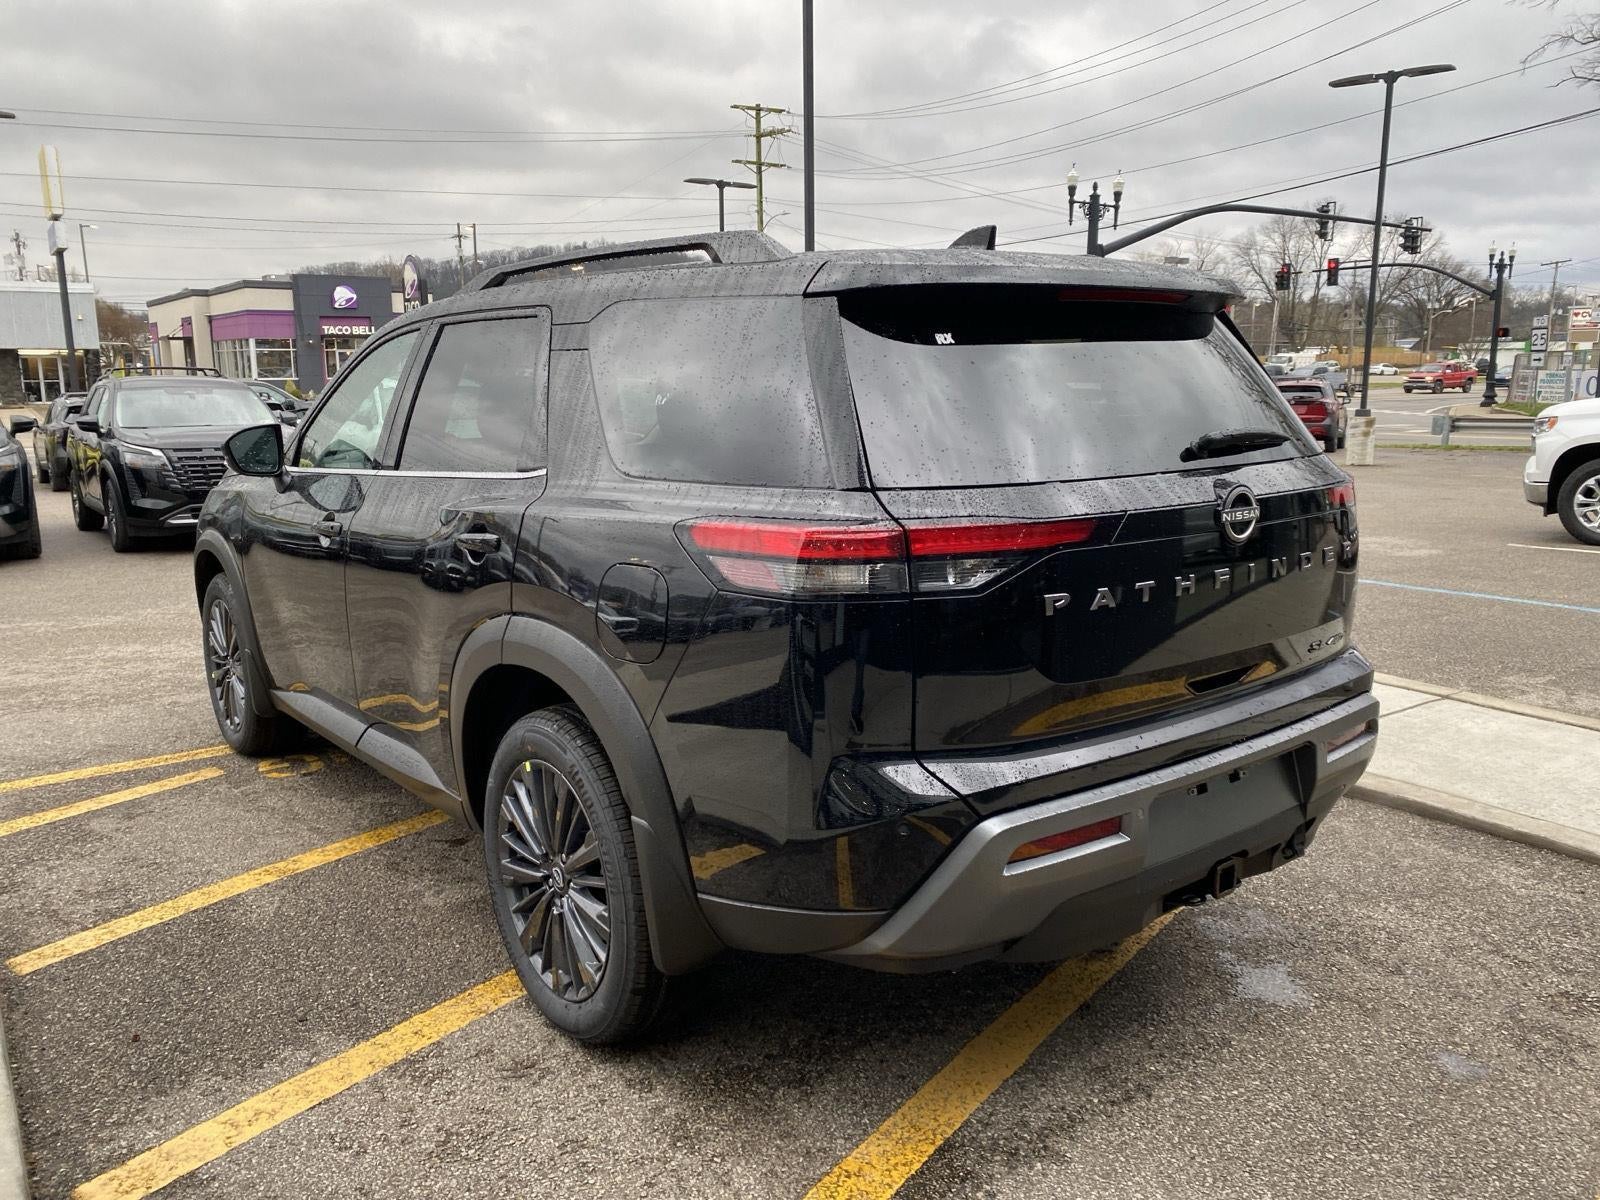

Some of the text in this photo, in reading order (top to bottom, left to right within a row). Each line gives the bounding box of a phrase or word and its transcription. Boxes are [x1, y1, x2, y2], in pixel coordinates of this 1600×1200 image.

[404, 301, 420, 312] TACO
[322, 326, 375, 335] TACO BELL
[935, 333, 955, 344] RX
[1532, 333, 1546, 346] 25
[1222, 508, 1260, 522] NISSAN
[1043, 541, 1352, 616] PATHFINDER
